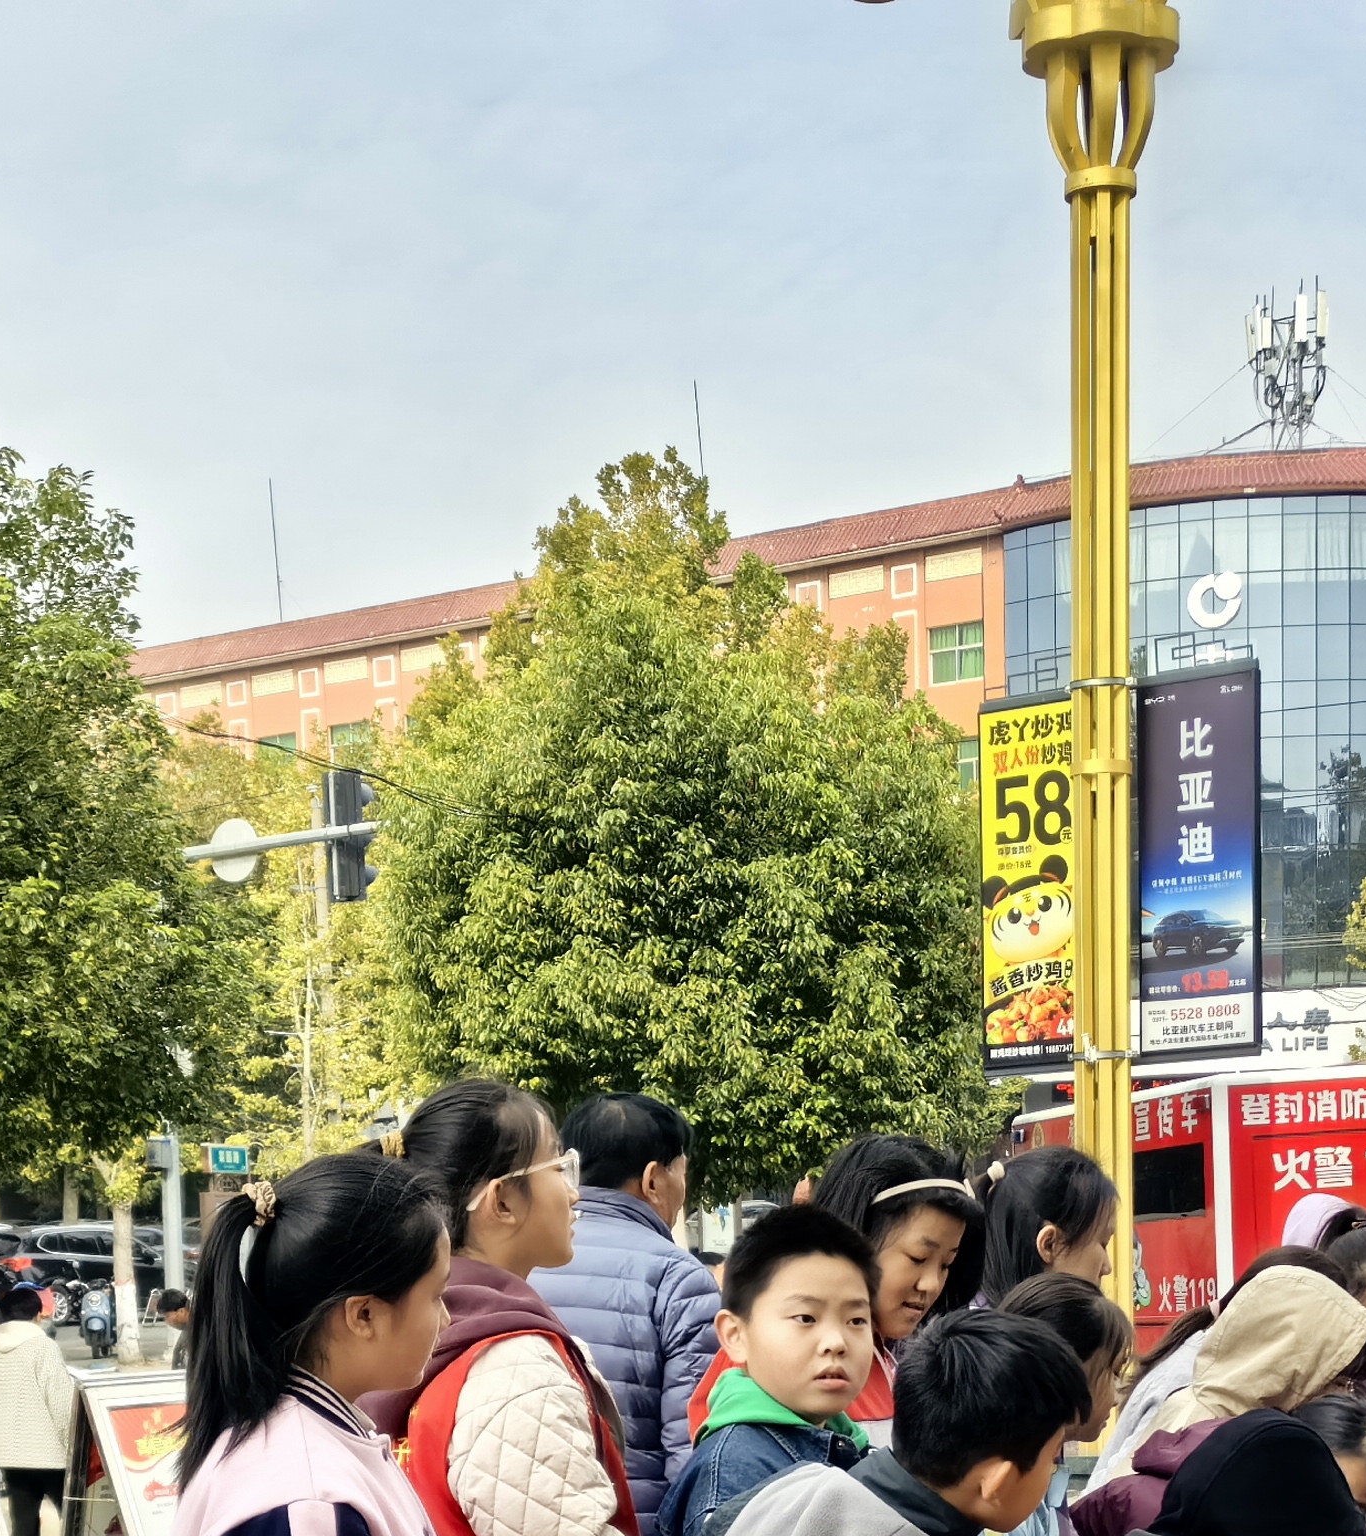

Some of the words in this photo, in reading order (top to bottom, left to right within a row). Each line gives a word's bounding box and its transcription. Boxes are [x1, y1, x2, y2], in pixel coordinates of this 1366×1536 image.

[1177, 717, 1215, 865] 比亚迪
[995, 769, 1072, 846] 58
[989, 960, 1063, 998] 酱香炒鸡
[1170, 1006, 1203, 1021] 5528
[1207, 1003, 1241, 1018] 0808
[1266, 1008, 1332, 1033] 人寿
[1162, 1020, 1234, 1036] 比亚迪汽车王朝网
[1282, 1036, 1329, 1051] LIFE
[1272, 1145, 1353, 1191] 火警
